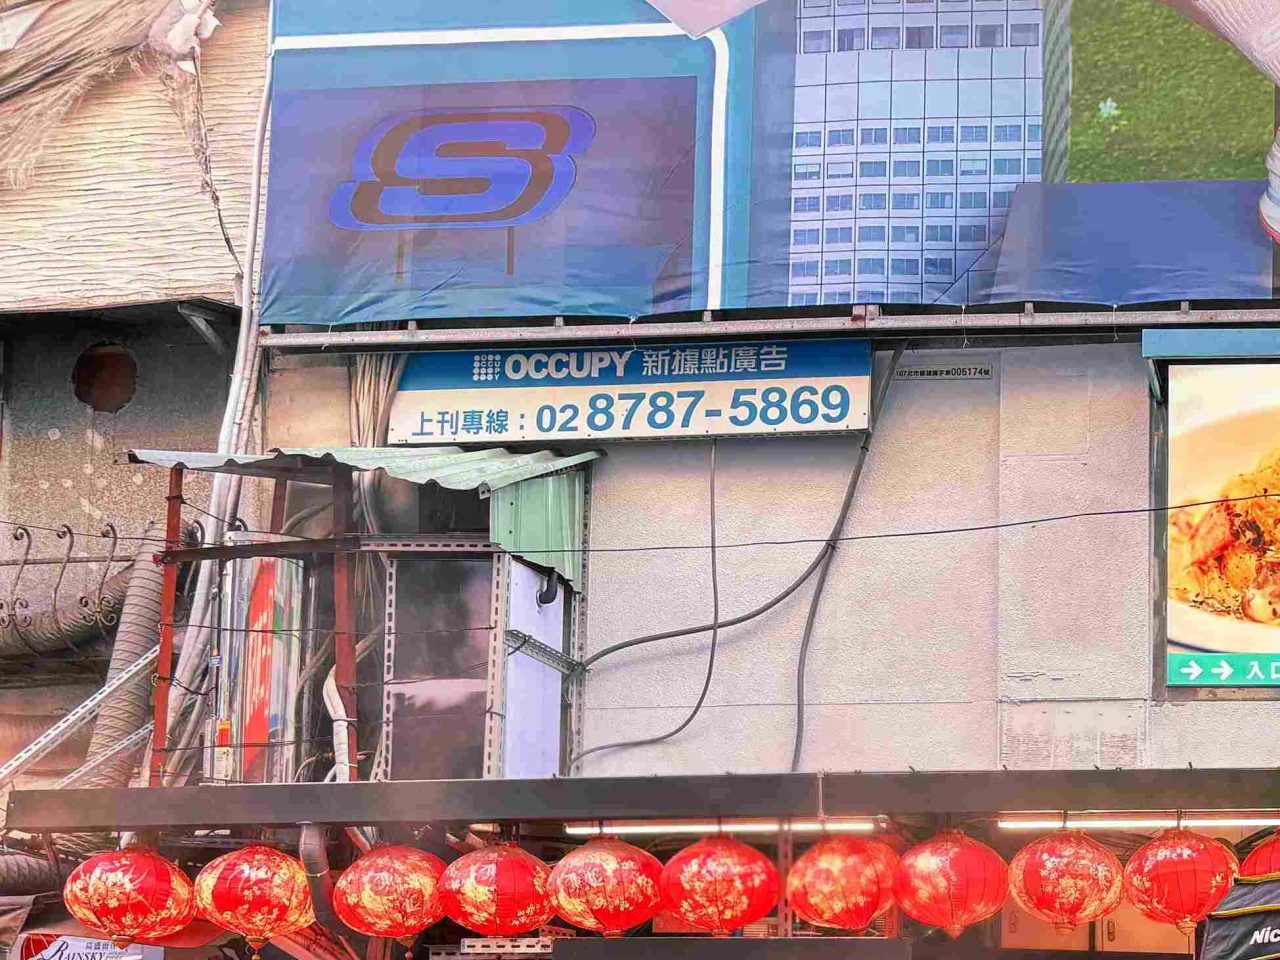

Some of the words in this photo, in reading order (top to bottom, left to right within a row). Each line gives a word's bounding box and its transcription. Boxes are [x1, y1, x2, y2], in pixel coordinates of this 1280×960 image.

[504, 350, 631, 380] OCCUPY
[642, 345, 788, 376] 新據點廣告
[535, 404, 580, 433] 02
[586, 384, 851, 431] 8787-5869
